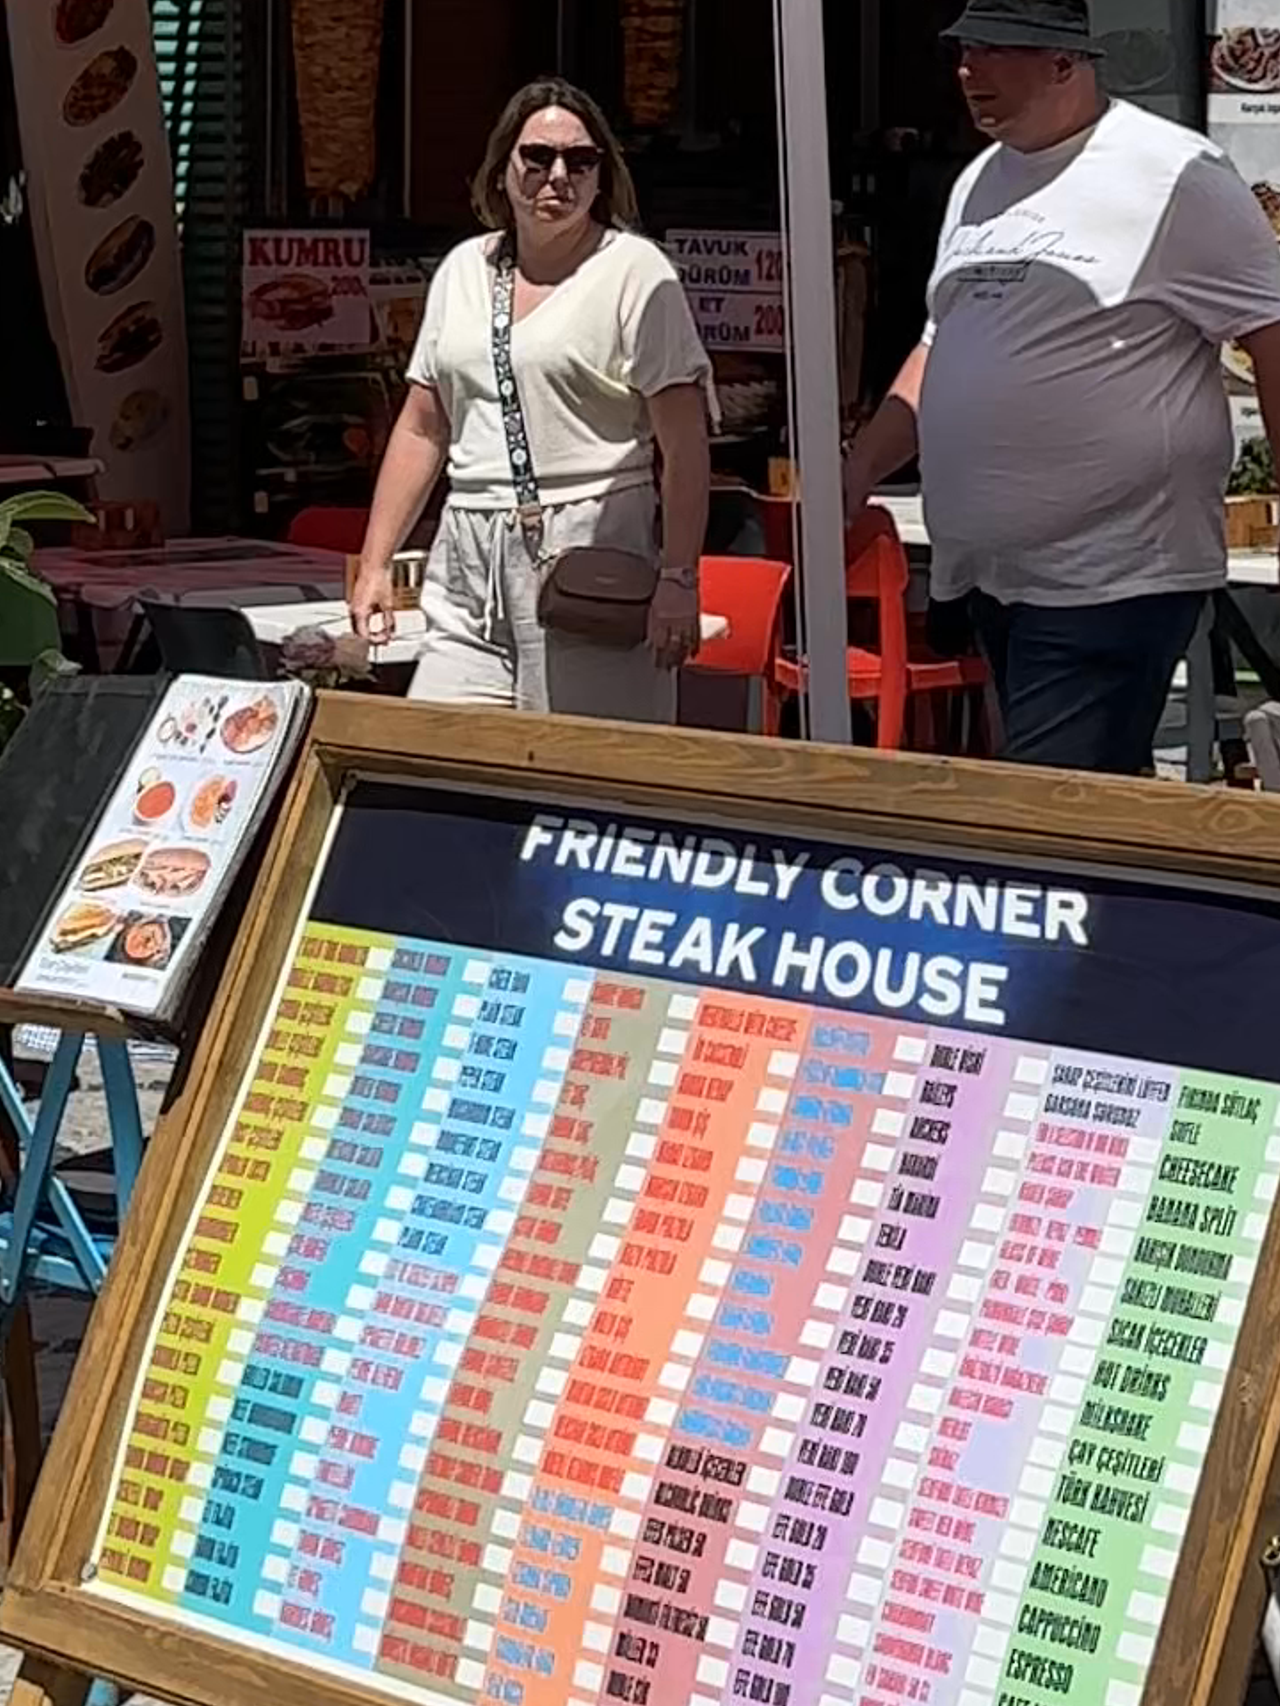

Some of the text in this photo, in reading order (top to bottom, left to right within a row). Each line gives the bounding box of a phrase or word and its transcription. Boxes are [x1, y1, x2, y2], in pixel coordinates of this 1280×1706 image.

[248, 237, 366, 268] KUMRU
[675, 238, 749, 256] TAVUK
[698, 297, 725, 313] ET
[520, 813, 1091, 946] FRIENDLY CORNER
[553, 896, 1011, 1026] STEAK HOUSE
[1158, 1153, 1240, 1195] CHEESECAKE
[1198, 1204, 1238, 1238] SPLİT
[1067, 1438, 1166, 1493] ÇAY ÇEŞİTLERİ
[1041, 1517, 1102, 1559] NESCAFE
[1005, 1648, 1074, 1695] ESPRESSO
